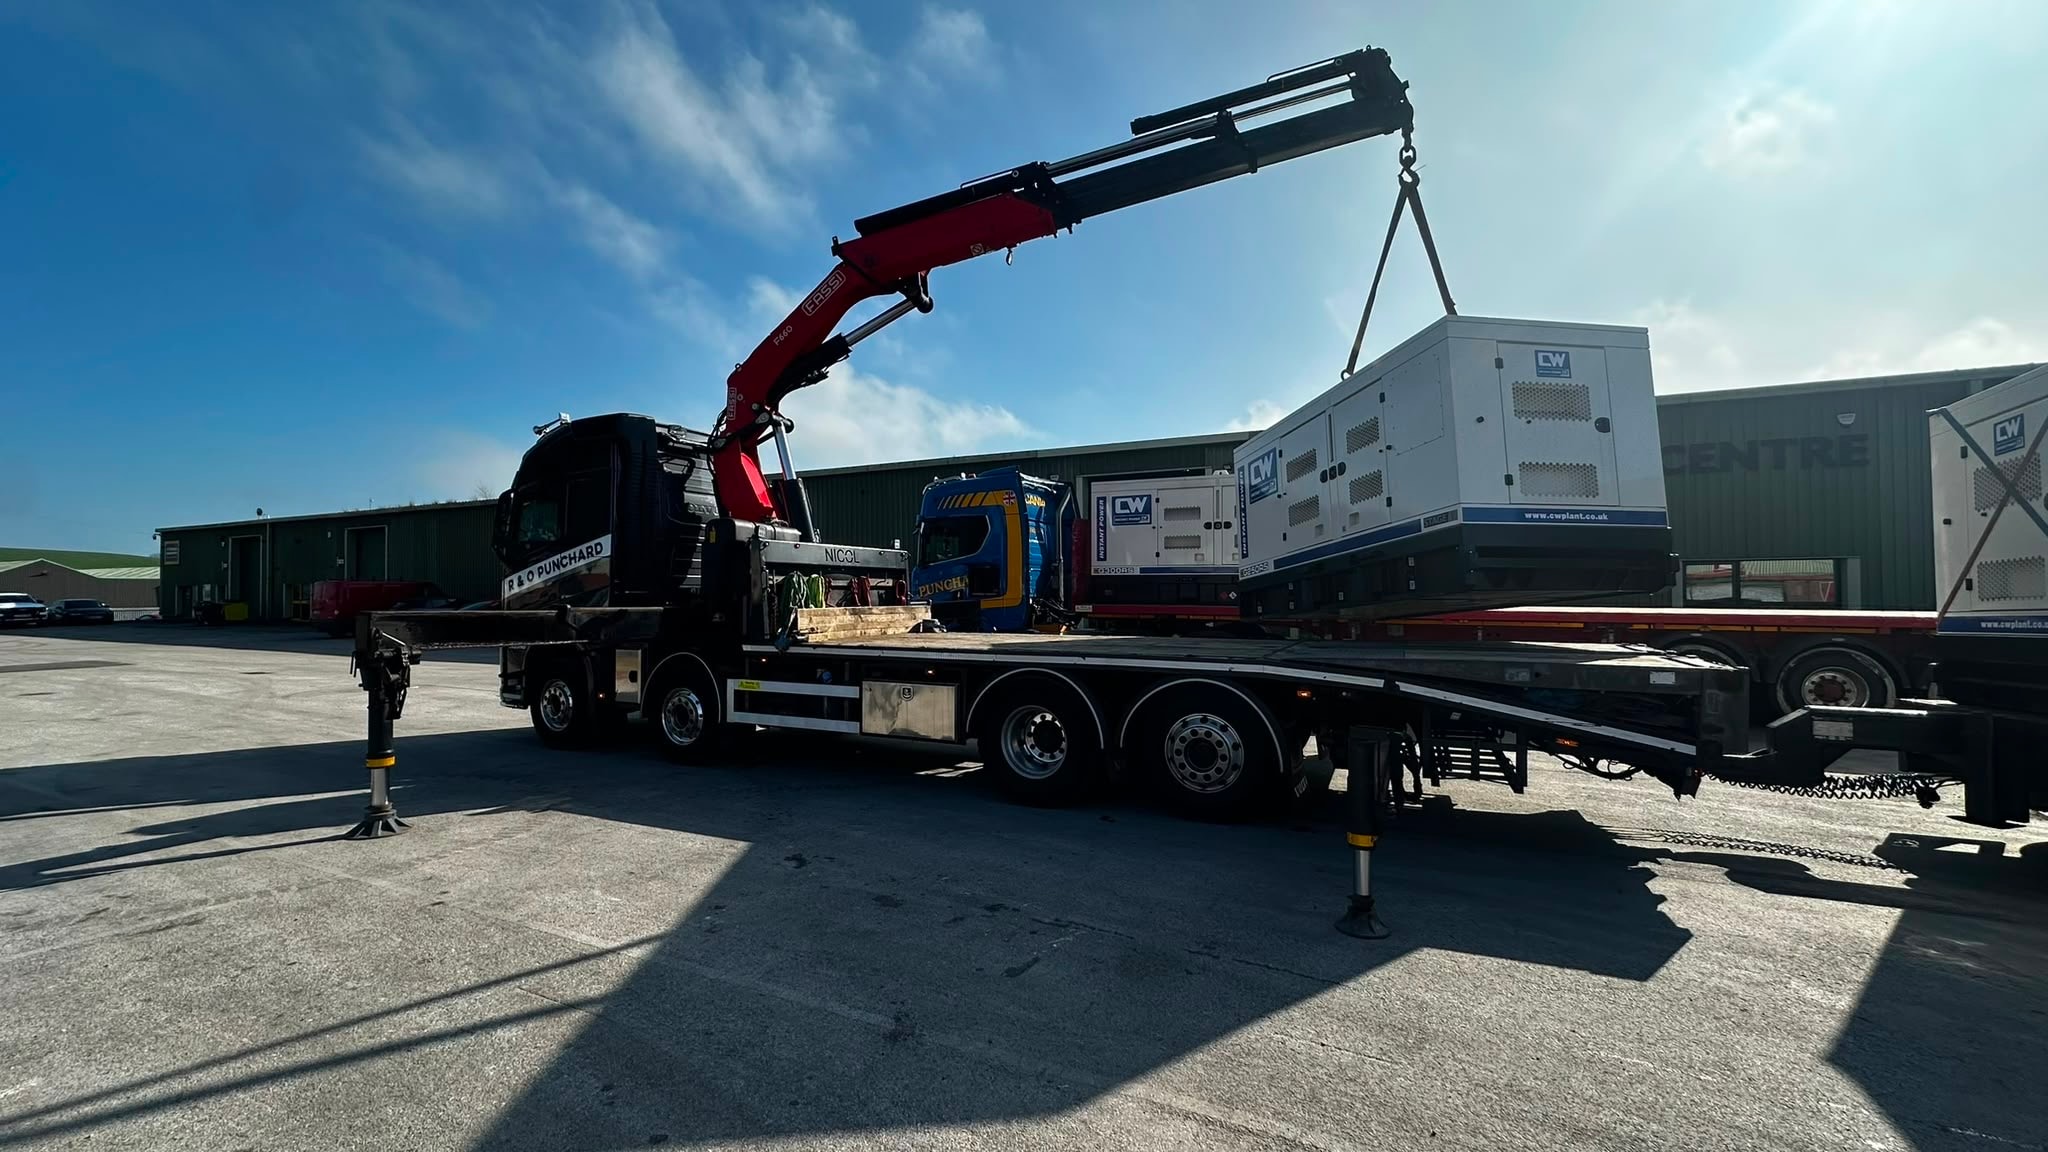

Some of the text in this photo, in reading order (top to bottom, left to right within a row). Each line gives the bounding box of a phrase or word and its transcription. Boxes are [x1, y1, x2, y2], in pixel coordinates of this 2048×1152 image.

[806, 273, 843, 313] FASSI
[1538, 352, 1566, 367] CW
[1996, 416, 2021, 440] CW
[1664, 434, 1869, 475] CENTRE
[1250, 452, 1273, 486] CW
[1115, 497, 1147, 513] CW
[1525, 512, 1608, 521] www.cwplant.co.uk
[508, 542, 603, 592] R & O PUNCHARD
[825, 548, 860, 564] NICOL
